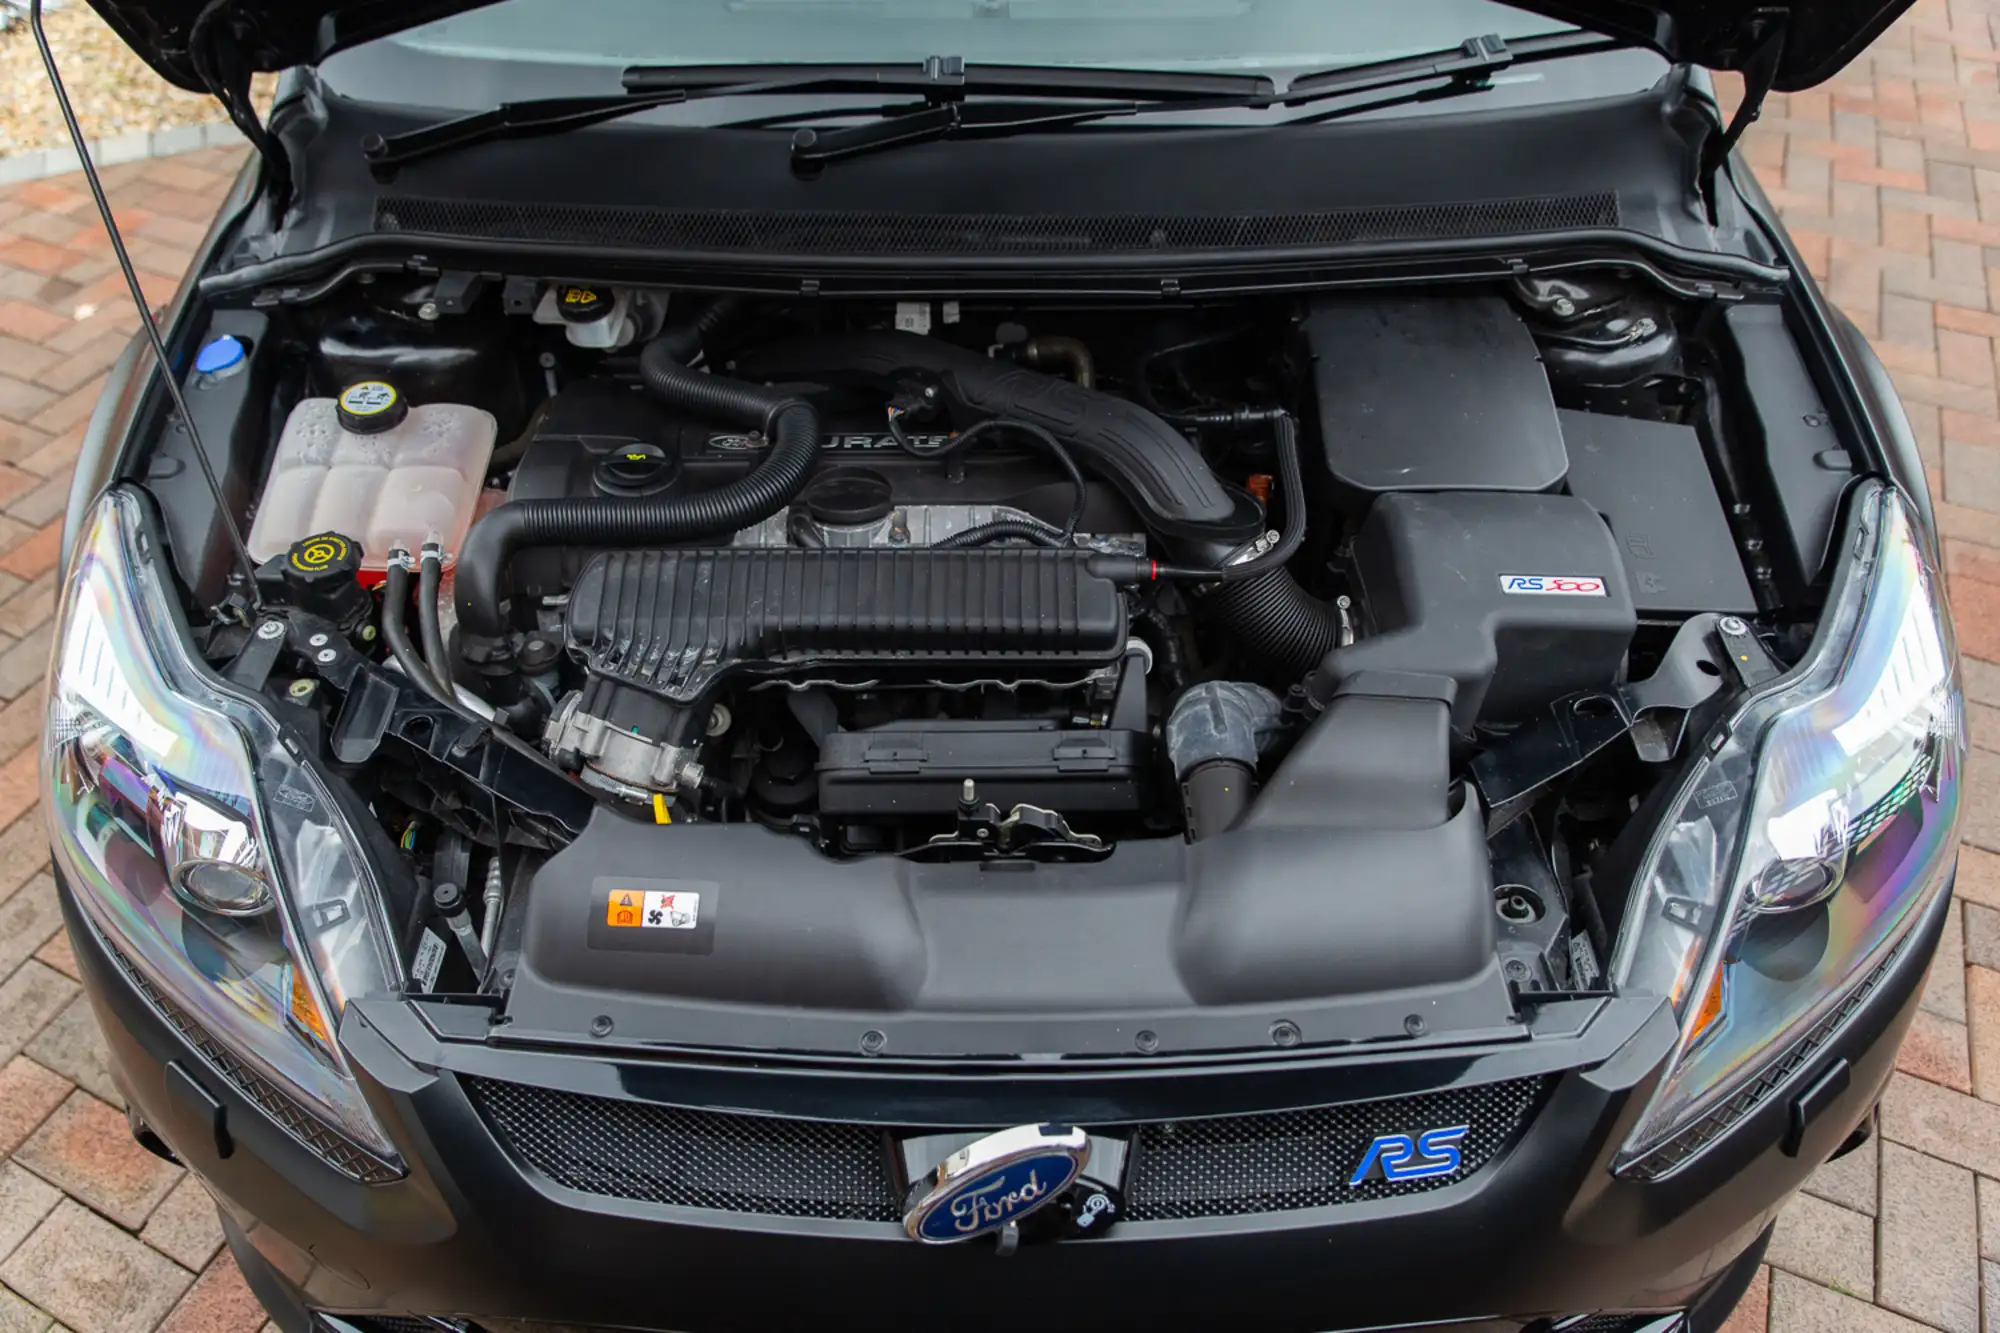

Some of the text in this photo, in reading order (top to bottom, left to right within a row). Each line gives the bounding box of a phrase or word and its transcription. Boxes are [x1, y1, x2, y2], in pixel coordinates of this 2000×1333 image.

[1508, 578, 1600, 592] RS 500
[1349, 1124, 1470, 1185] RS
[950, 1169, 1047, 1232] Ford
